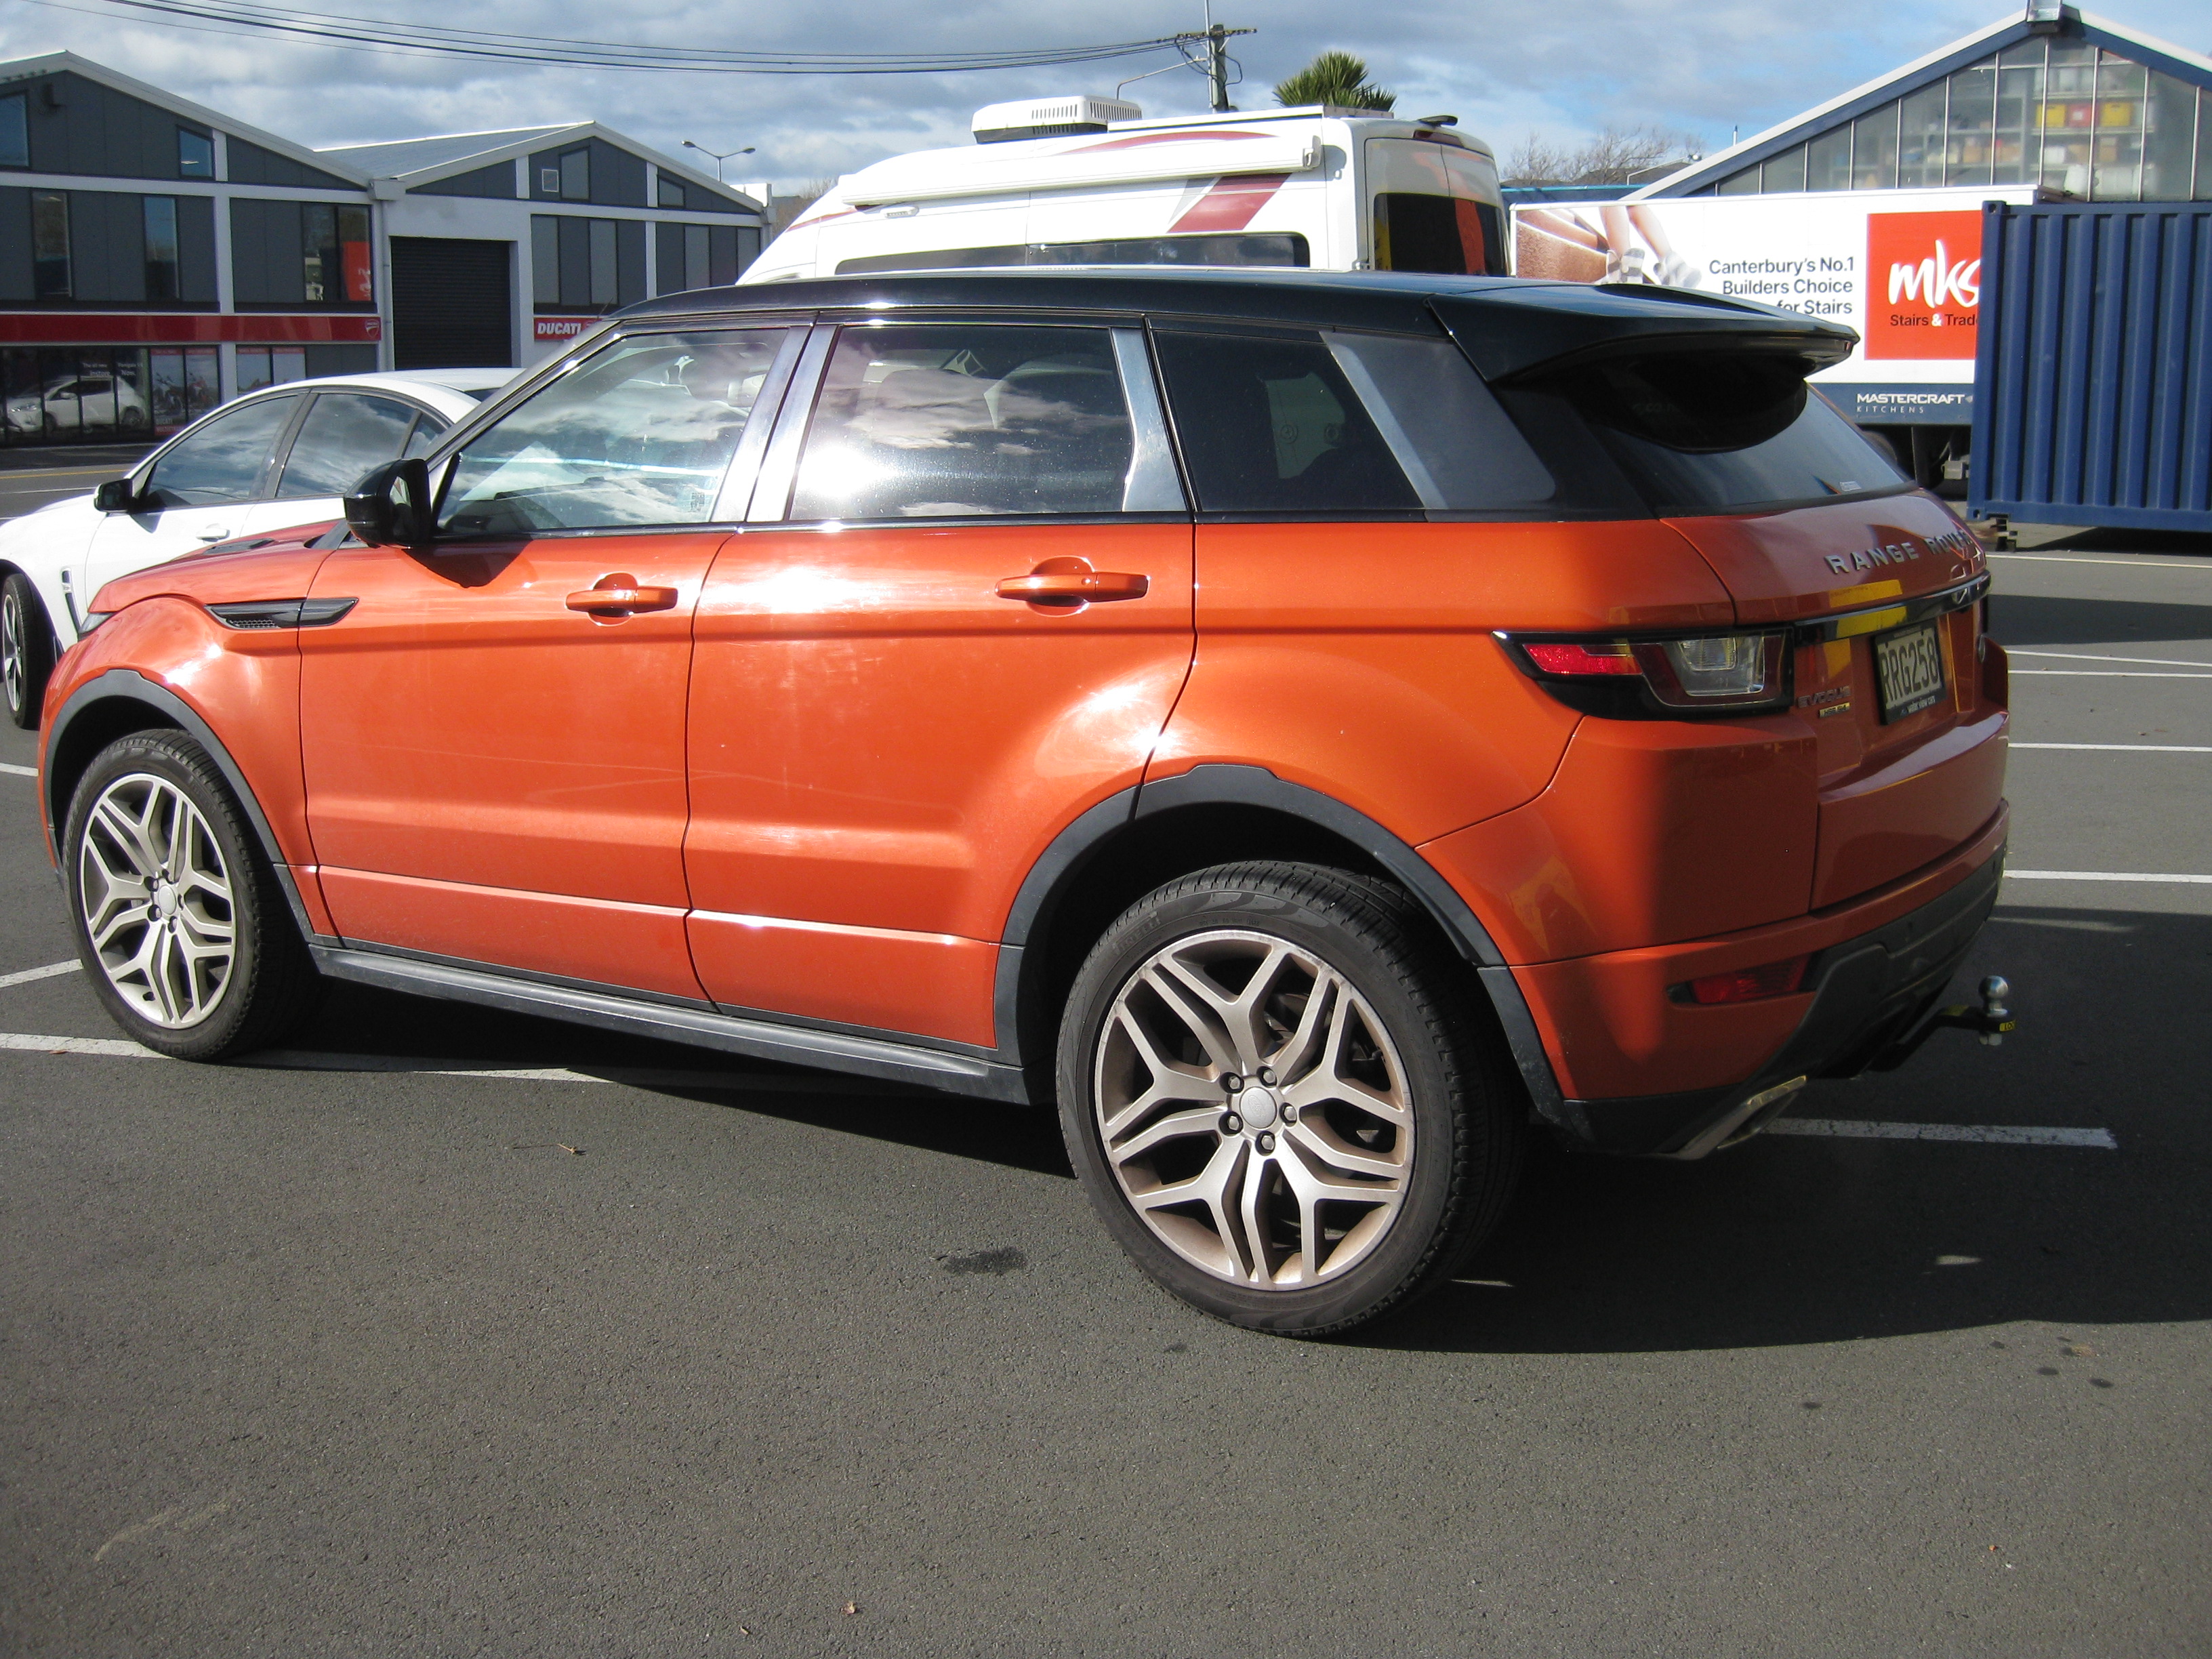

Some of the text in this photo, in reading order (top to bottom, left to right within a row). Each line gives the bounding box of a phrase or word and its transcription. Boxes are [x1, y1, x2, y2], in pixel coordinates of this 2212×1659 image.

[1708, 256, 1854, 276] Canterbury's No.1
[1723, 278, 1853, 294] Builders Choice
[1804, 299, 1853, 314] Stairs
[1890, 313, 1978, 327] Stairs & Trad
[537, 322, 582, 335] DUCATI
[1857, 393, 1965, 404] MASTERCRAFT
[1824, 529, 1973, 574] RANGE ROVER
[1879, 636, 1939, 703] RRG258
[1798, 685, 1851, 709] EVOQUE
